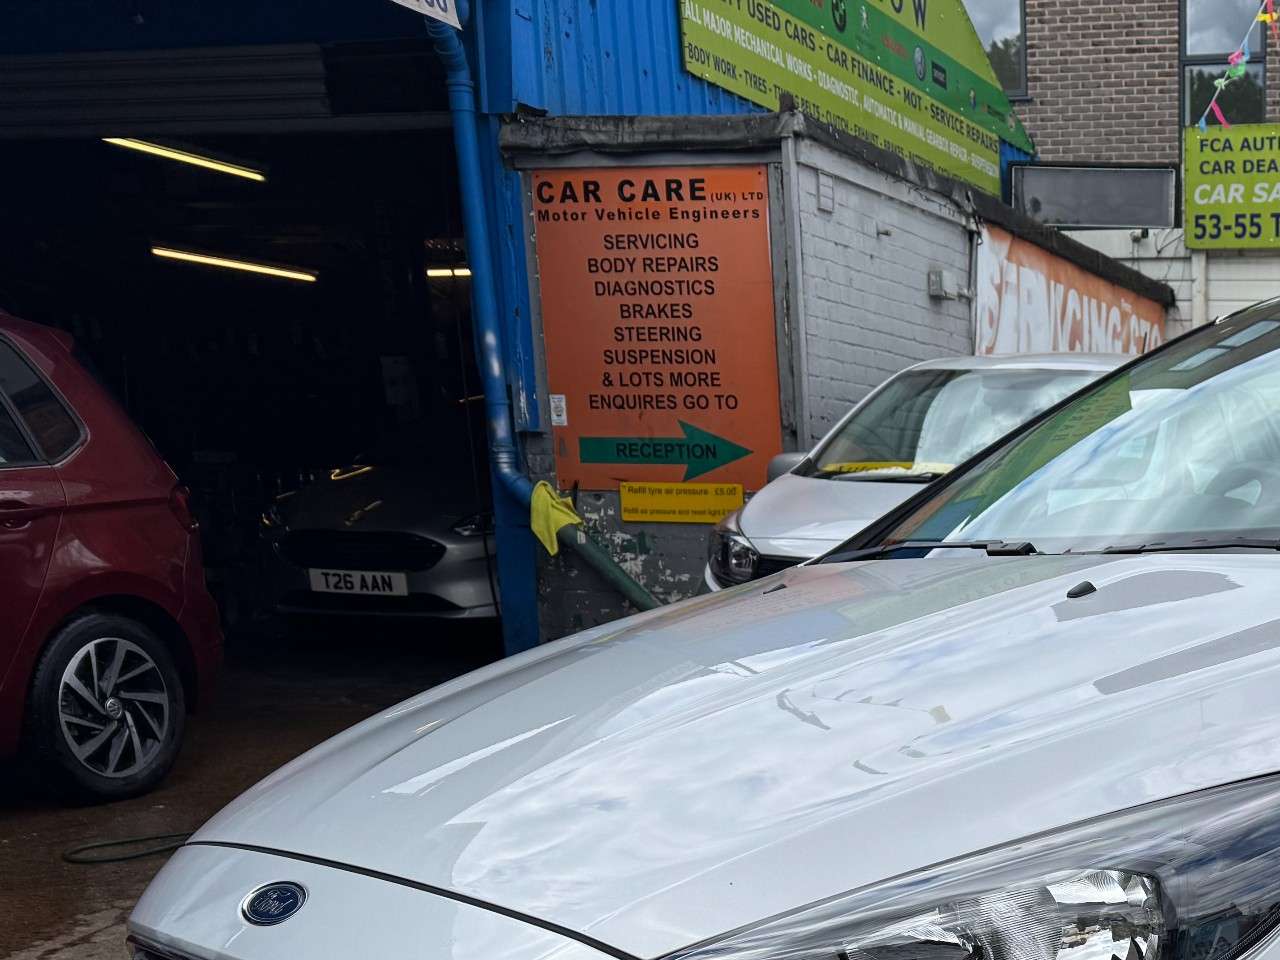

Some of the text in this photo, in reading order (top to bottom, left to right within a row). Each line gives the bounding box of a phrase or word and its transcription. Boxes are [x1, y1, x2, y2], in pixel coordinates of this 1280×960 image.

[684, 0, 702, 24] ALL
[703, 8, 733, 40] MAJOR
[734, 24, 785, 67] MECHANICAL
[786, 52, 813, 81] WORKS
[688, 43, 711, 67] BODY
[712, 55, 737, 79] WORK
[744, 69, 768, 94] TYRES
[747, 0, 781, 31] USED
[785, 20, 816, 51] CARS
[827, 45, 849, 70] CAR
[851, 57, 894, 96] FINANCE
[903, 87, 922, 111] MOT
[930, 104, 965, 135] SERVICE
[966, 123, 999, 153] REPAIRS
[1199, 138, 1235, 153] FCA
[1199, 160, 1237, 175] CAR
[535, 178, 764, 204] CAR CARE (UK) LTD
[1193, 184, 1245, 205] CAR
[537, 206, 761, 223] Motor Vehicle Engineers
[1193, 212, 1262, 240] 53-55
[603, 232, 699, 251] SERVICING
[587, 256, 719, 274] BODY REPAIRS
[594, 279, 715, 297] DIAGNOSTICS
[619, 303, 693, 320] BRAKES
[613, 326, 702, 342] STEERING
[603, 349, 716, 365] SUSPENSION
[602, 371, 721, 388] & LOTS MORE
[589, 394, 738, 411] ENQUIRES GO TO
[615, 442, 717, 459] RECEPTION
[675, 486, 709, 497] pressure
[321, 572, 393, 593] T26 AAN
